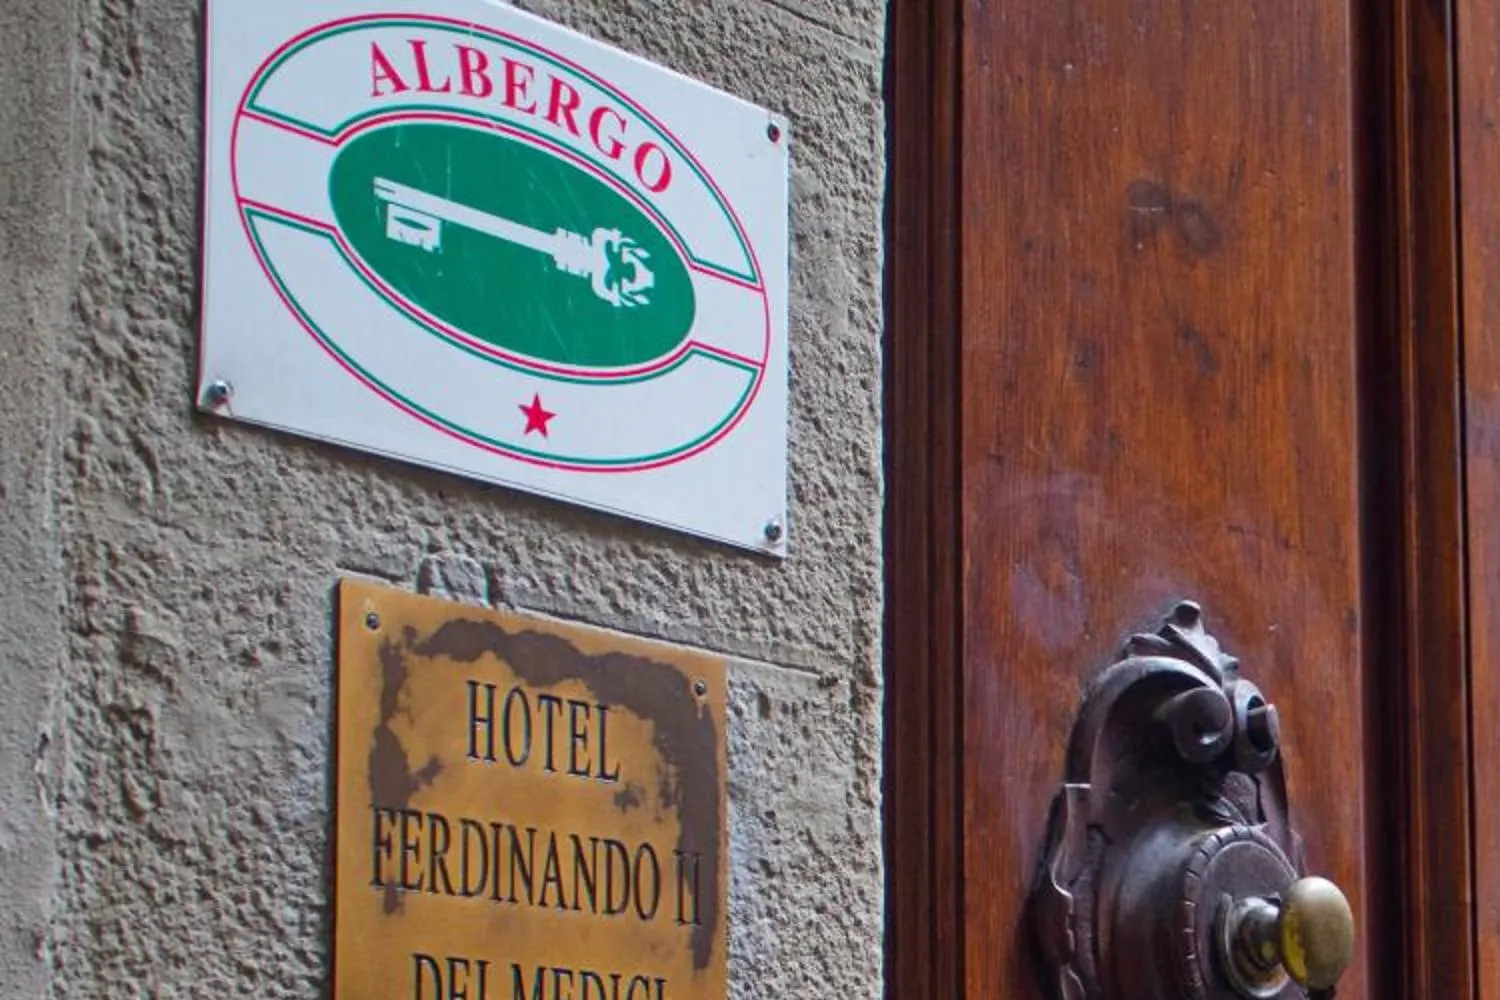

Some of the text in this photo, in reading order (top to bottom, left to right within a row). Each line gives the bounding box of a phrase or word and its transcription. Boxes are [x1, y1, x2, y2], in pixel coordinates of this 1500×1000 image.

[369, 38, 674, 194] ALBERGO
[465, 679, 620, 783] HOTEL
[368, 804, 662, 923] FERDINANDO
